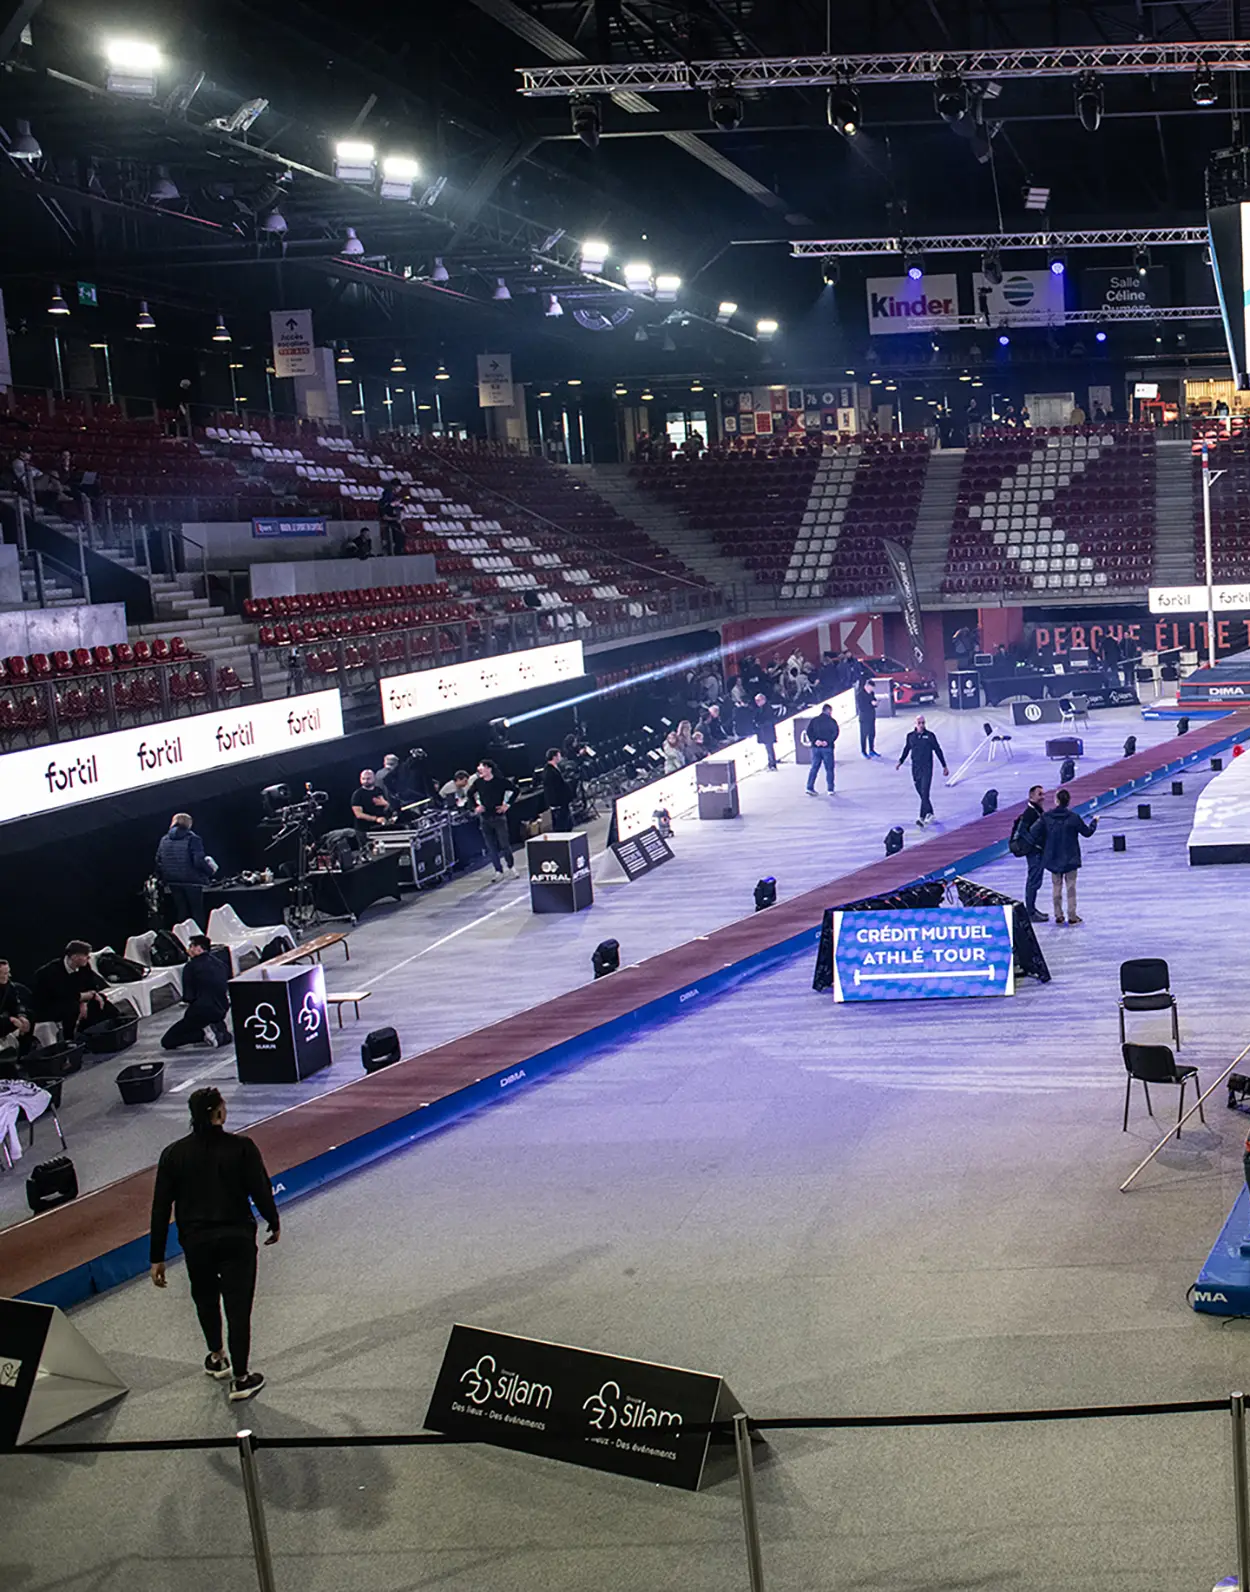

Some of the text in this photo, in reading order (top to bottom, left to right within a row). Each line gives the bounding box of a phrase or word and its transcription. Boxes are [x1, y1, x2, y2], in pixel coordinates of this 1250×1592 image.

[1110, 277, 1140, 288] Salle
[1106, 290, 1146, 301] Céline
[1209, 687, 1244, 695] DIMA
[287, 708, 321, 735] fortil
[216, 721, 254, 752] fortil
[137, 737, 182, 771] fortil
[45, 755, 98, 793] fortil
[856, 925, 992, 943] CRÉDIT MUTUEL
[863, 947, 986, 965] ATHLÉ TOUR
[500, 1070, 526, 1087] DIMA
[451, 1401, 465, 1412] Des
[466, 1405, 484, 1416] lieux
[489, 1410, 503, 1421] Des
[616, 1438, 630, 1450] Des
